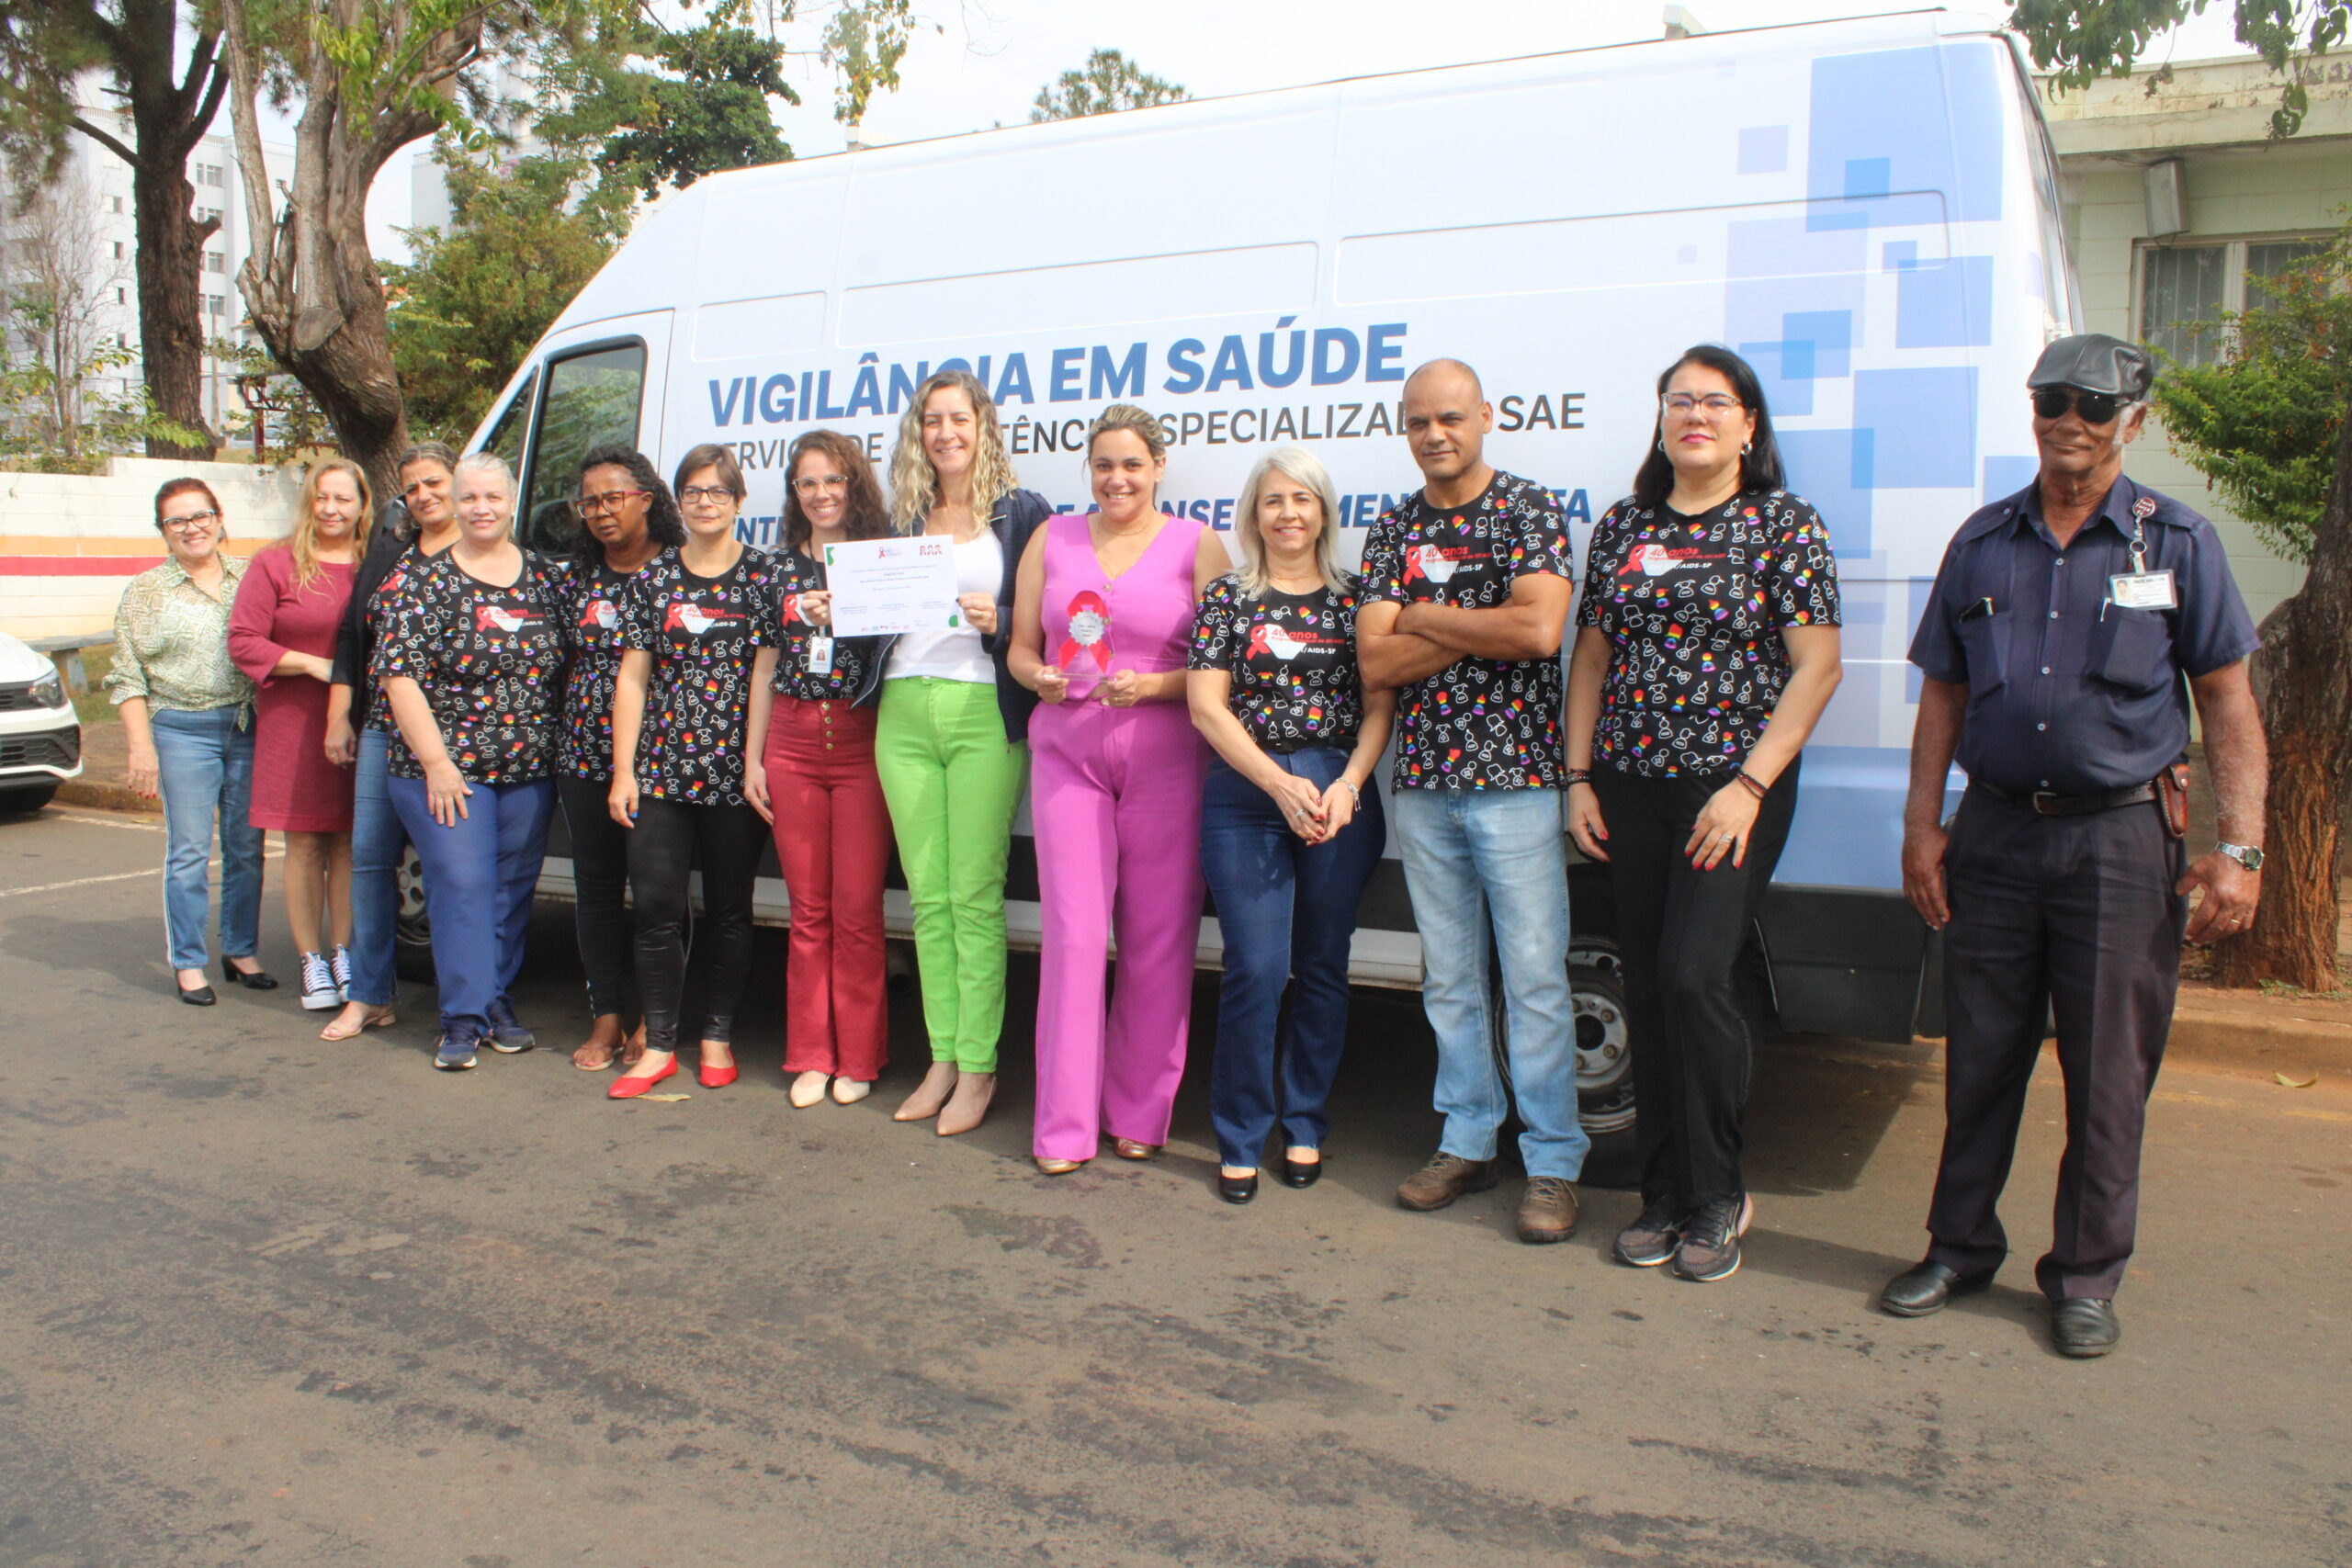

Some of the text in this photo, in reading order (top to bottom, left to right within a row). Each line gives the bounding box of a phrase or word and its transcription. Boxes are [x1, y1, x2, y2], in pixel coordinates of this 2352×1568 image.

[1049, 342, 1147, 402] EM
[1163, 315, 1408, 395] SAÚDE
[1498, 392, 1586, 432] SAE
[1289, 631, 1318, 639] anos
